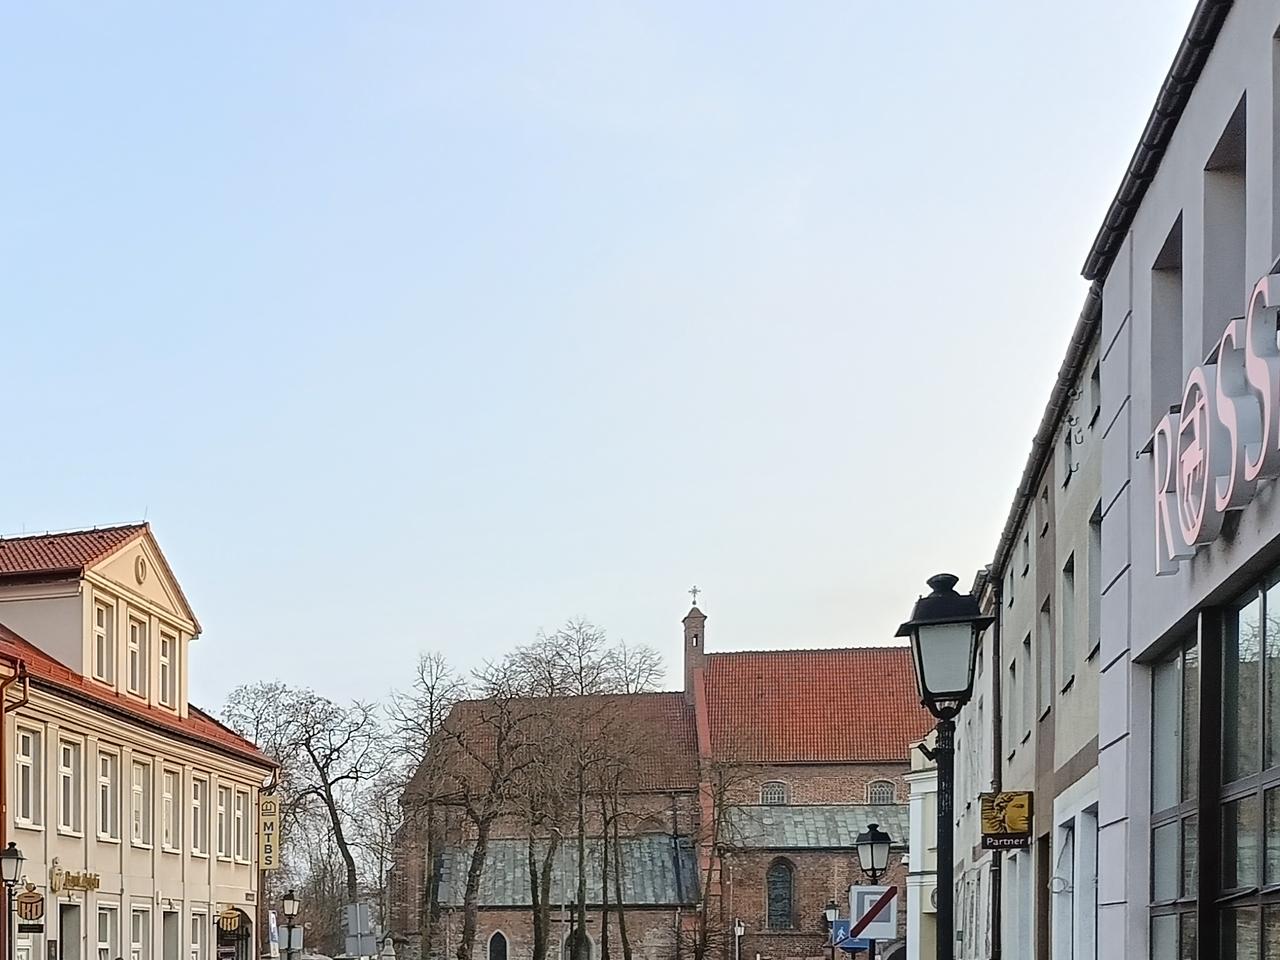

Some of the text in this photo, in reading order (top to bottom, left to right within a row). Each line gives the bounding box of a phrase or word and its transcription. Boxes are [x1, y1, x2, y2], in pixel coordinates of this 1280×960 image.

[1154, 276, 1280, 576] ROSS
[263, 822, 274, 866] MTBS
[986, 837, 1025, 846] Partner
